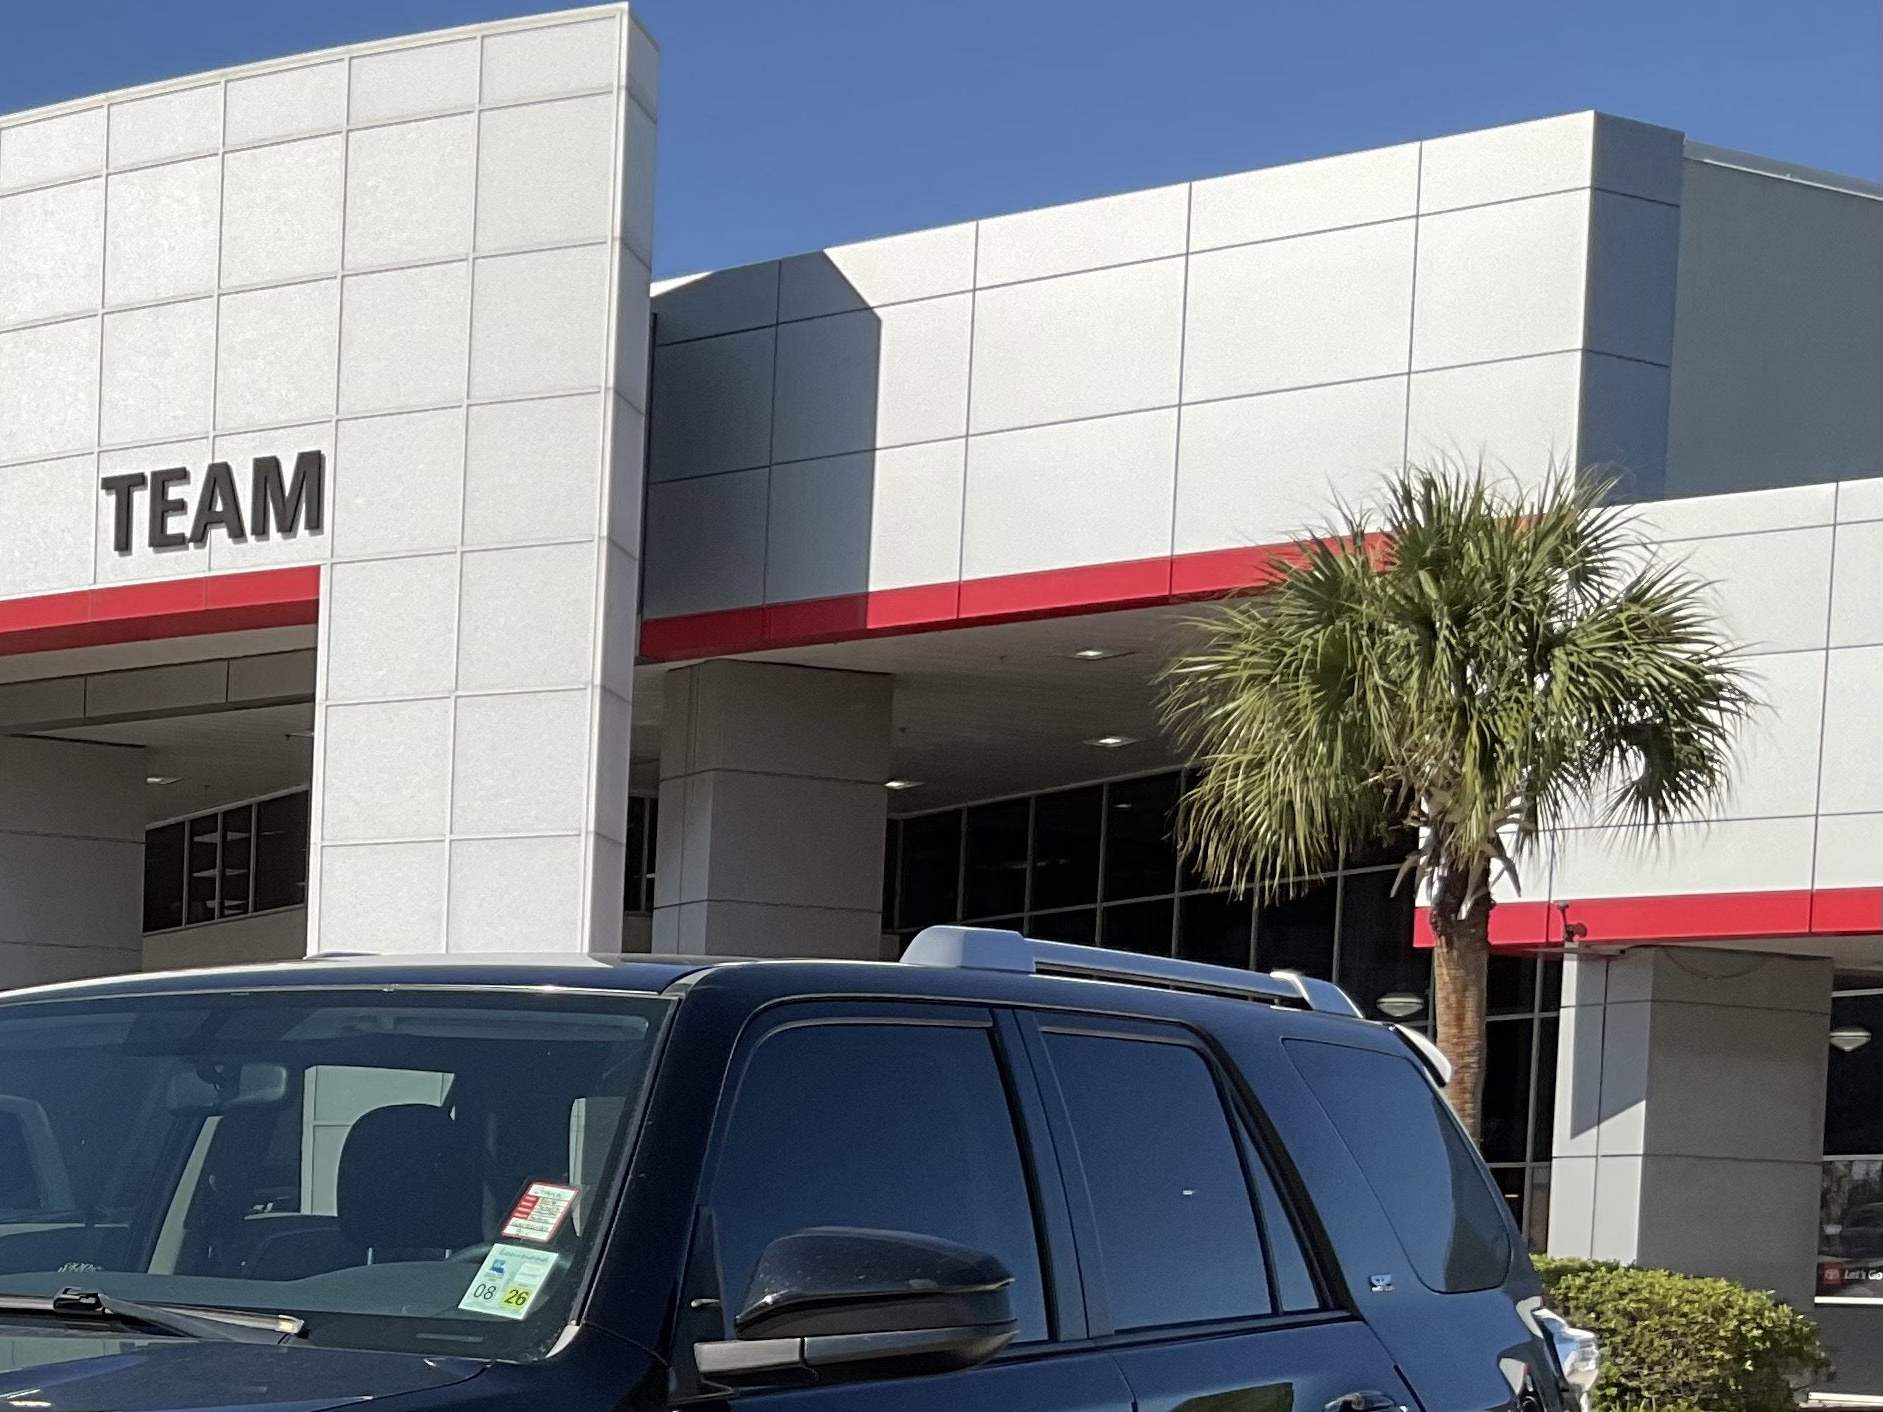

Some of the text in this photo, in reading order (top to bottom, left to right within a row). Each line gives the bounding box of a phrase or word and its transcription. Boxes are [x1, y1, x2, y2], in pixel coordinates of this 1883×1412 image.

[101, 449, 324, 555] TEAM
[473, 1283, 530, 1306] 08 26
